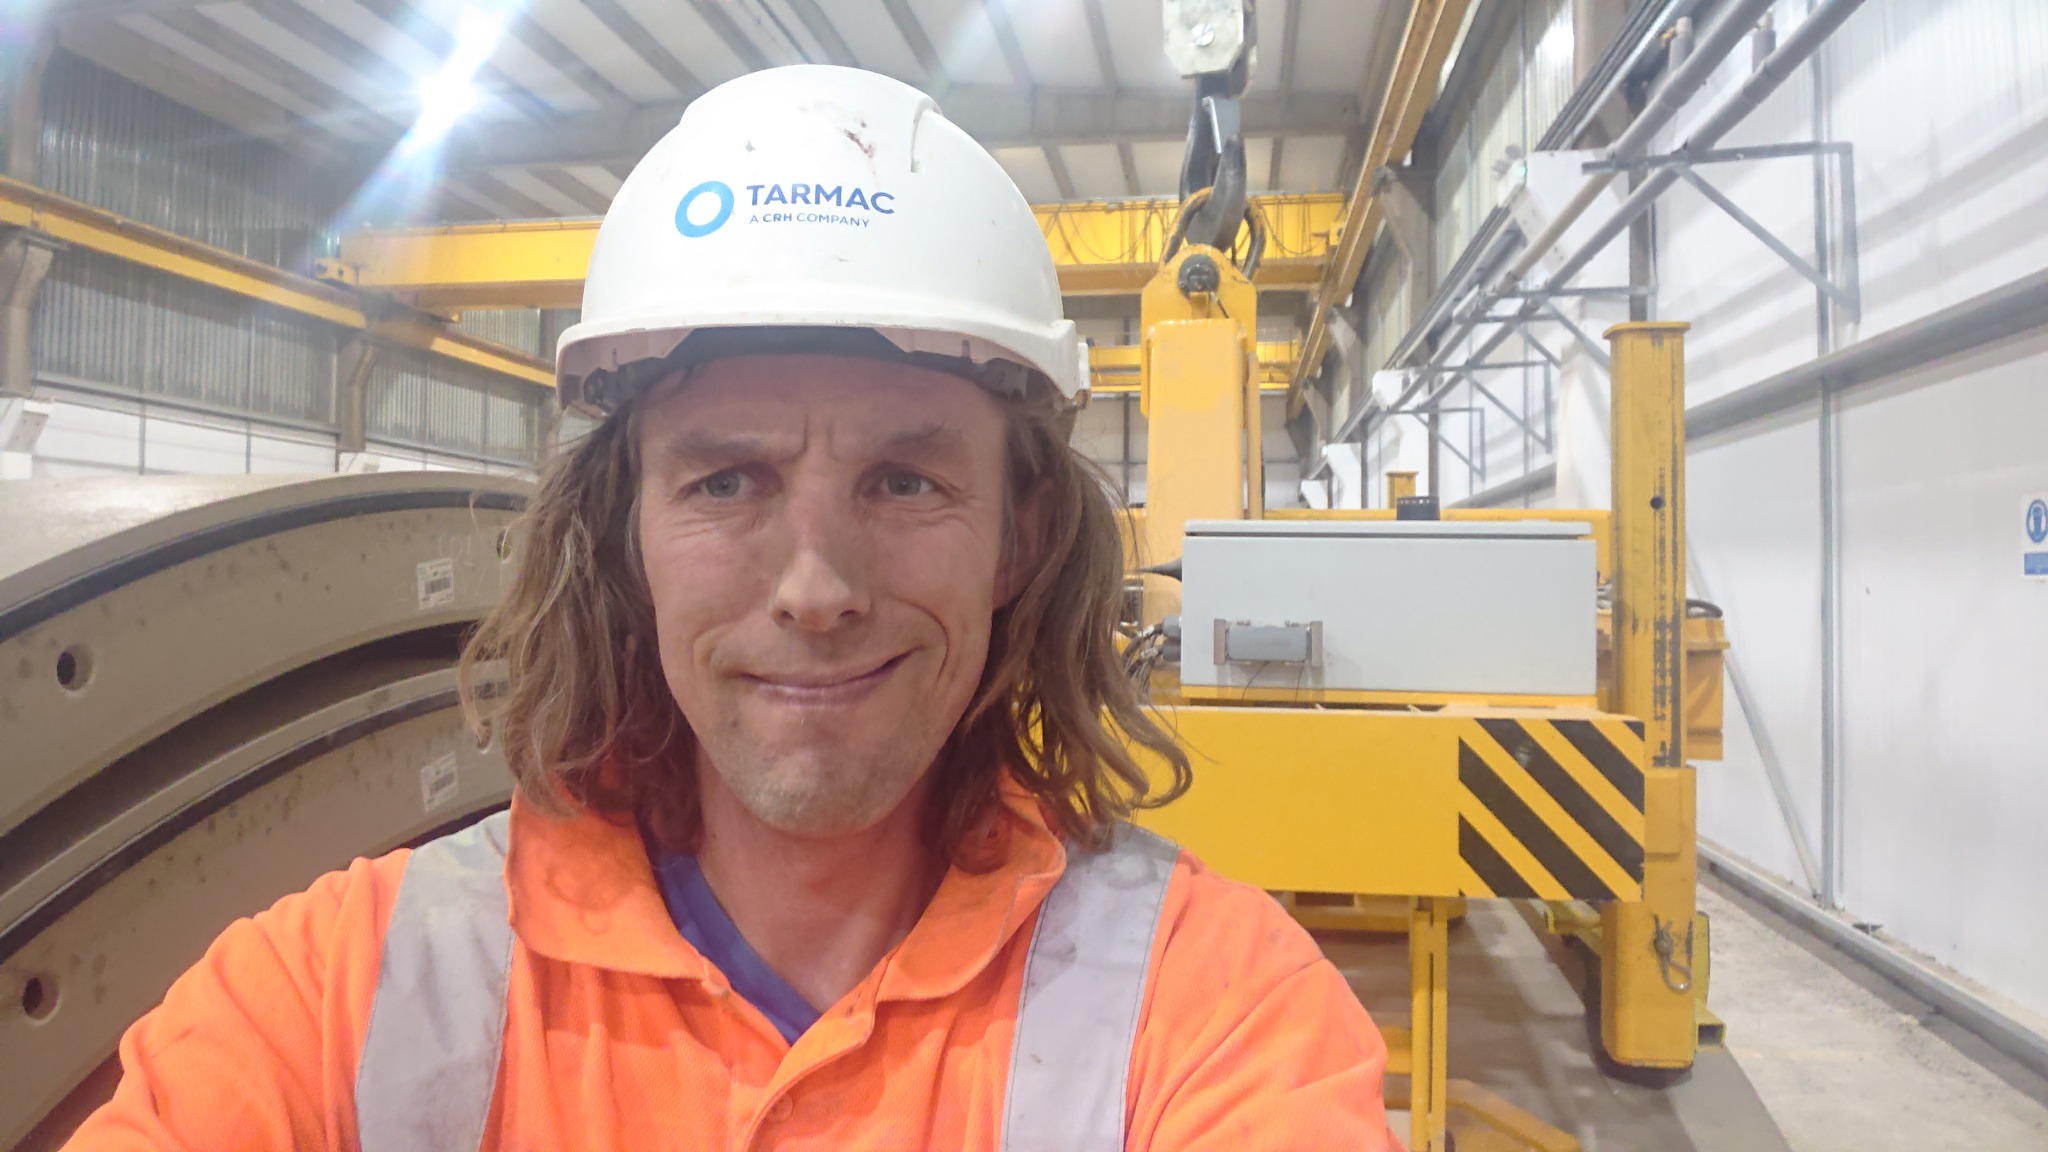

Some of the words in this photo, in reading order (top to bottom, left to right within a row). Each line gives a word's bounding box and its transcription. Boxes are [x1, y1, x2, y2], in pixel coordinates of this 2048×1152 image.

[746, 183, 895, 214] TARMAC
[750, 215, 759, 224] A
[762, 213, 792, 223] CRH
[796, 213, 870, 227] COMPANY
